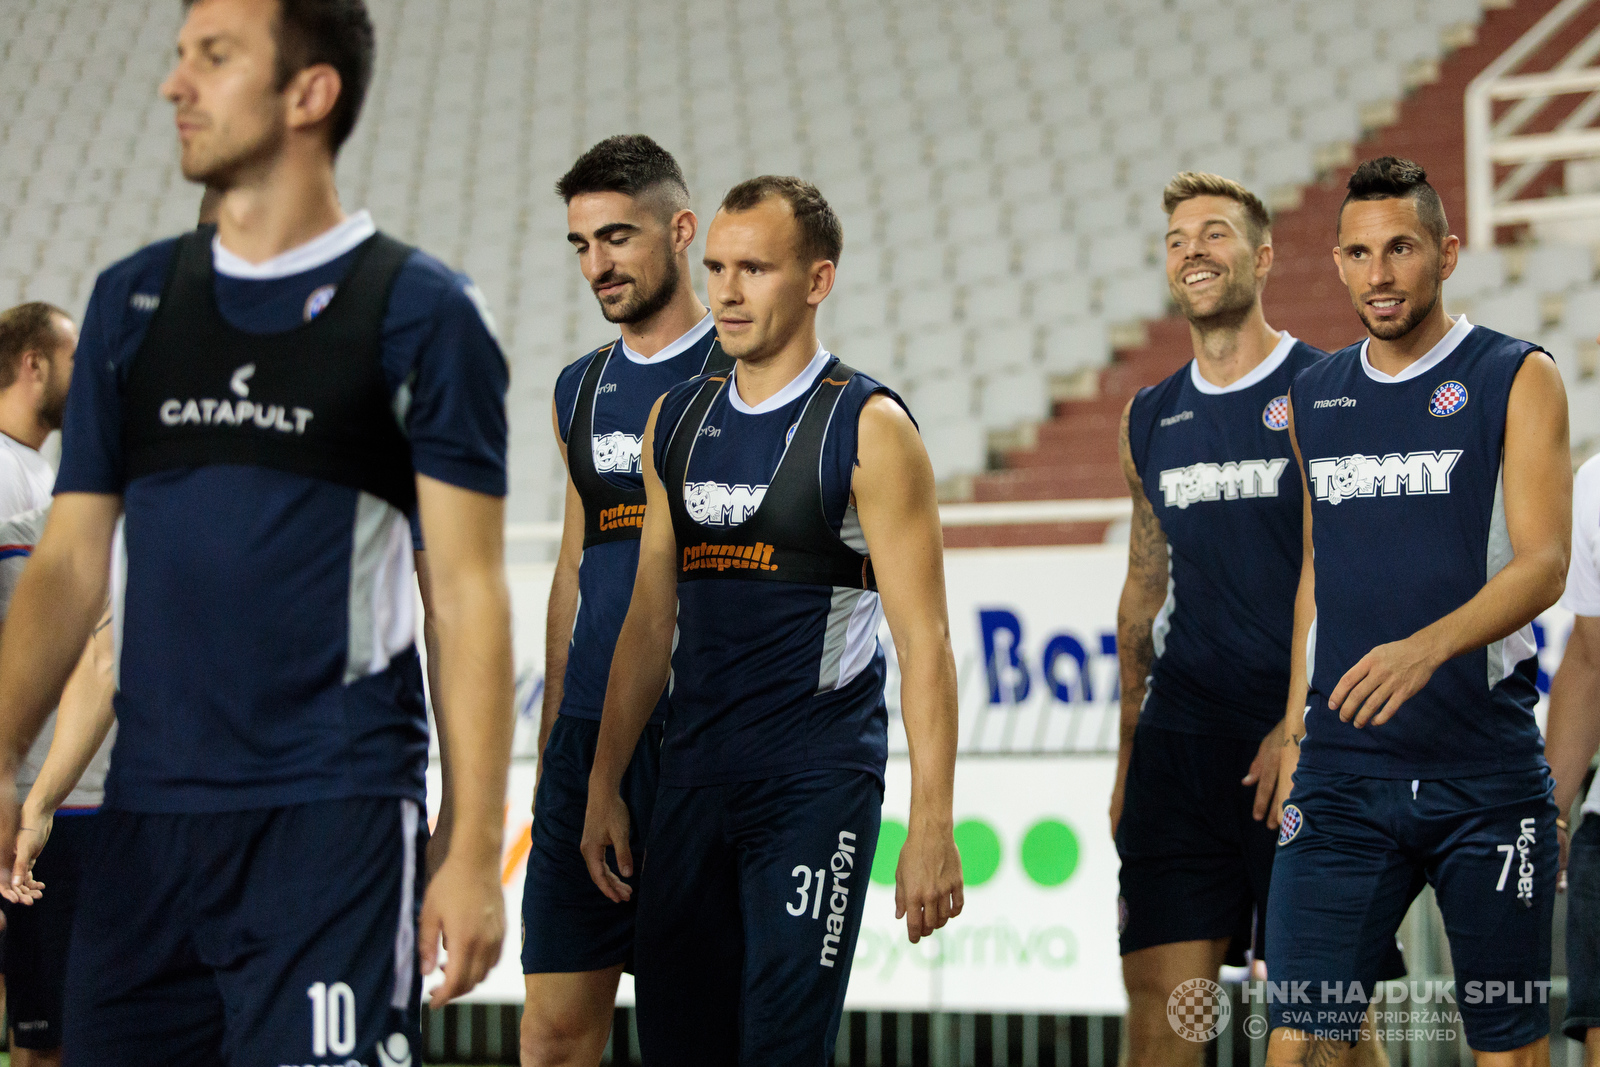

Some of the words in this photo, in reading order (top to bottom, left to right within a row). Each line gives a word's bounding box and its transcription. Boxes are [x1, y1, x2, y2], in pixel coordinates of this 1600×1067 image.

[1313, 396, 1357, 409] macron
[1433, 406, 1455, 415] SPLIT
[1435, 383, 1464, 396] HAJDUK
[160, 399, 314, 434] CATAPULT
[1159, 458, 1290, 509] TOMMY
[1309, 449, 1464, 505] TOMMY
[786, 864, 826, 920] 31
[1495, 844, 1515, 892] 7
[820, 830, 857, 968] macron
[306, 981, 357, 1058] 10
